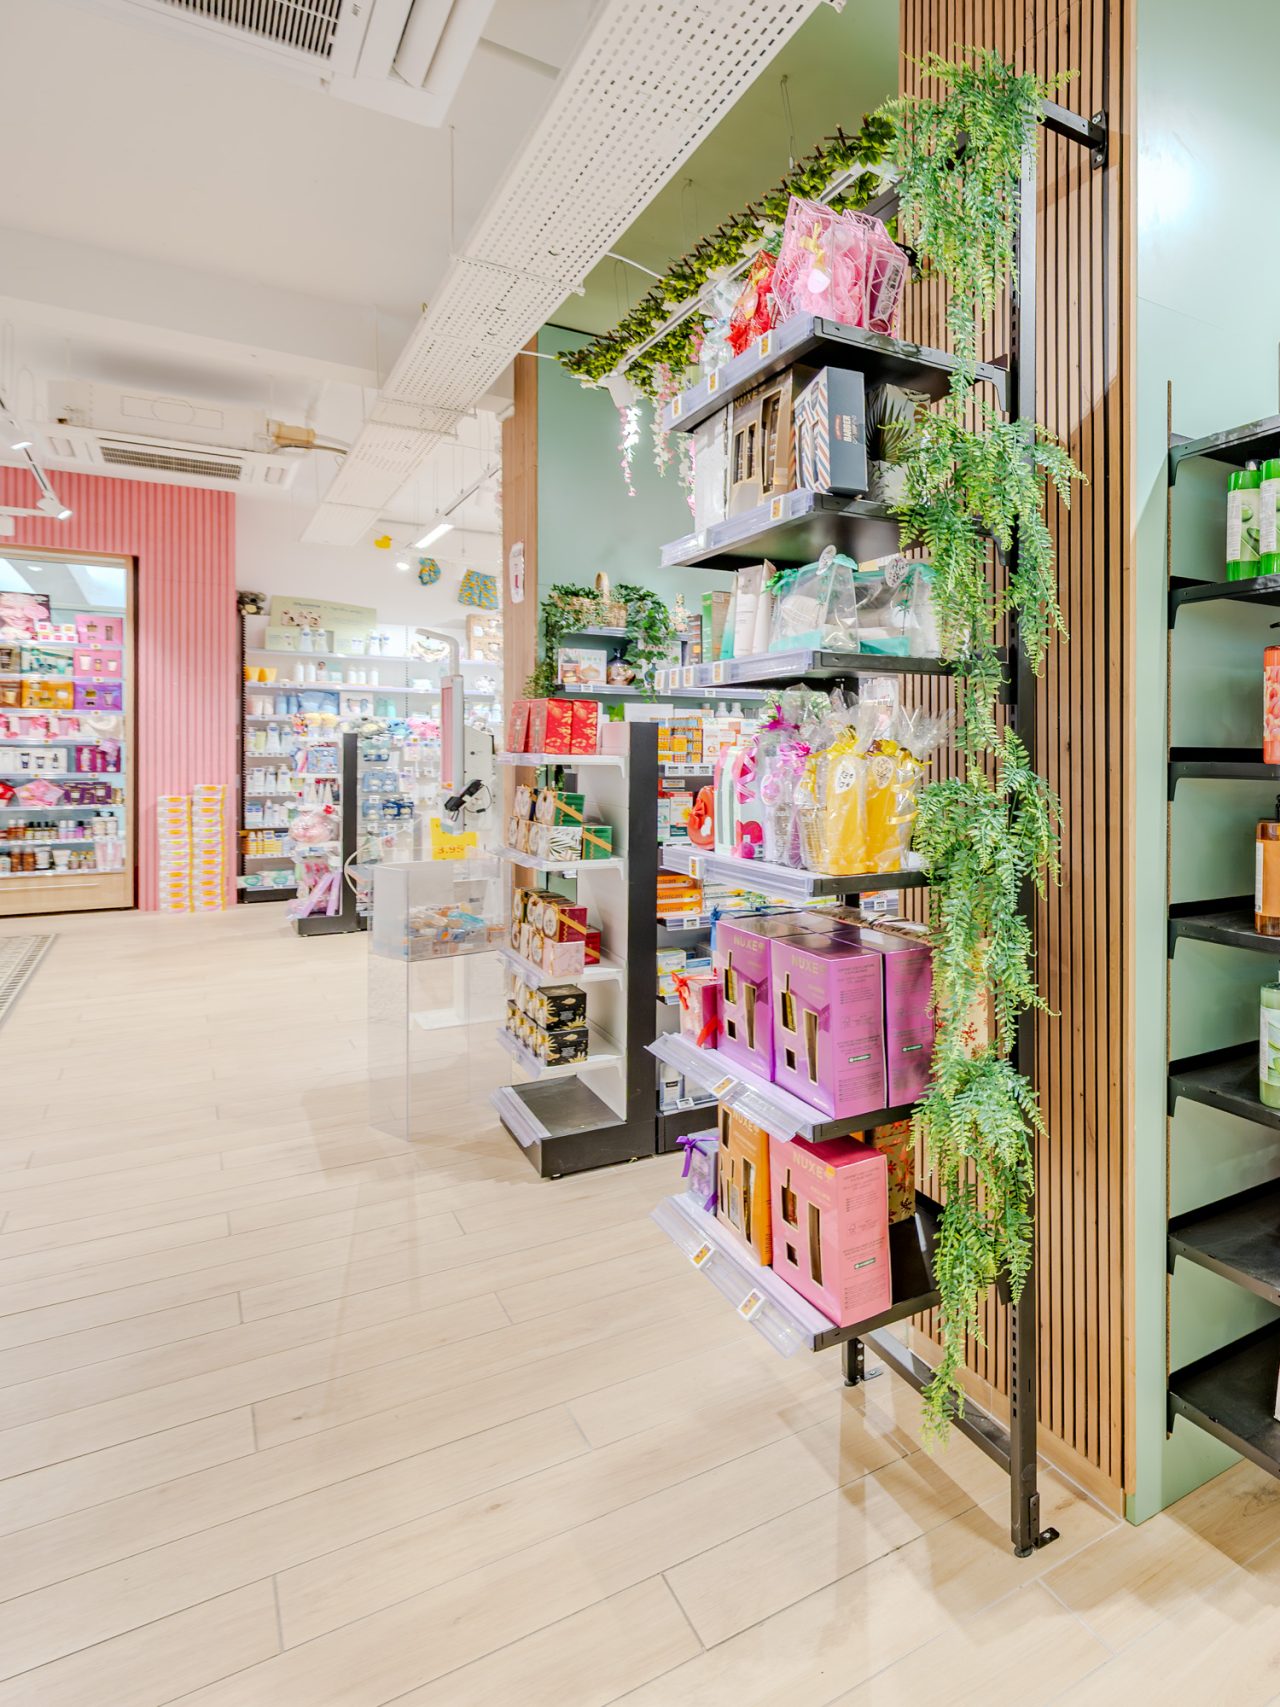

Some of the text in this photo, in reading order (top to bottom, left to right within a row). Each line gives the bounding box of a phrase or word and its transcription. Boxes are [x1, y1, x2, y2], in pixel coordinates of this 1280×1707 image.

[734, 936, 757, 952] NUXE
[792, 954, 819, 974] NUXE
[793, 1151, 824, 1180] NUXE
